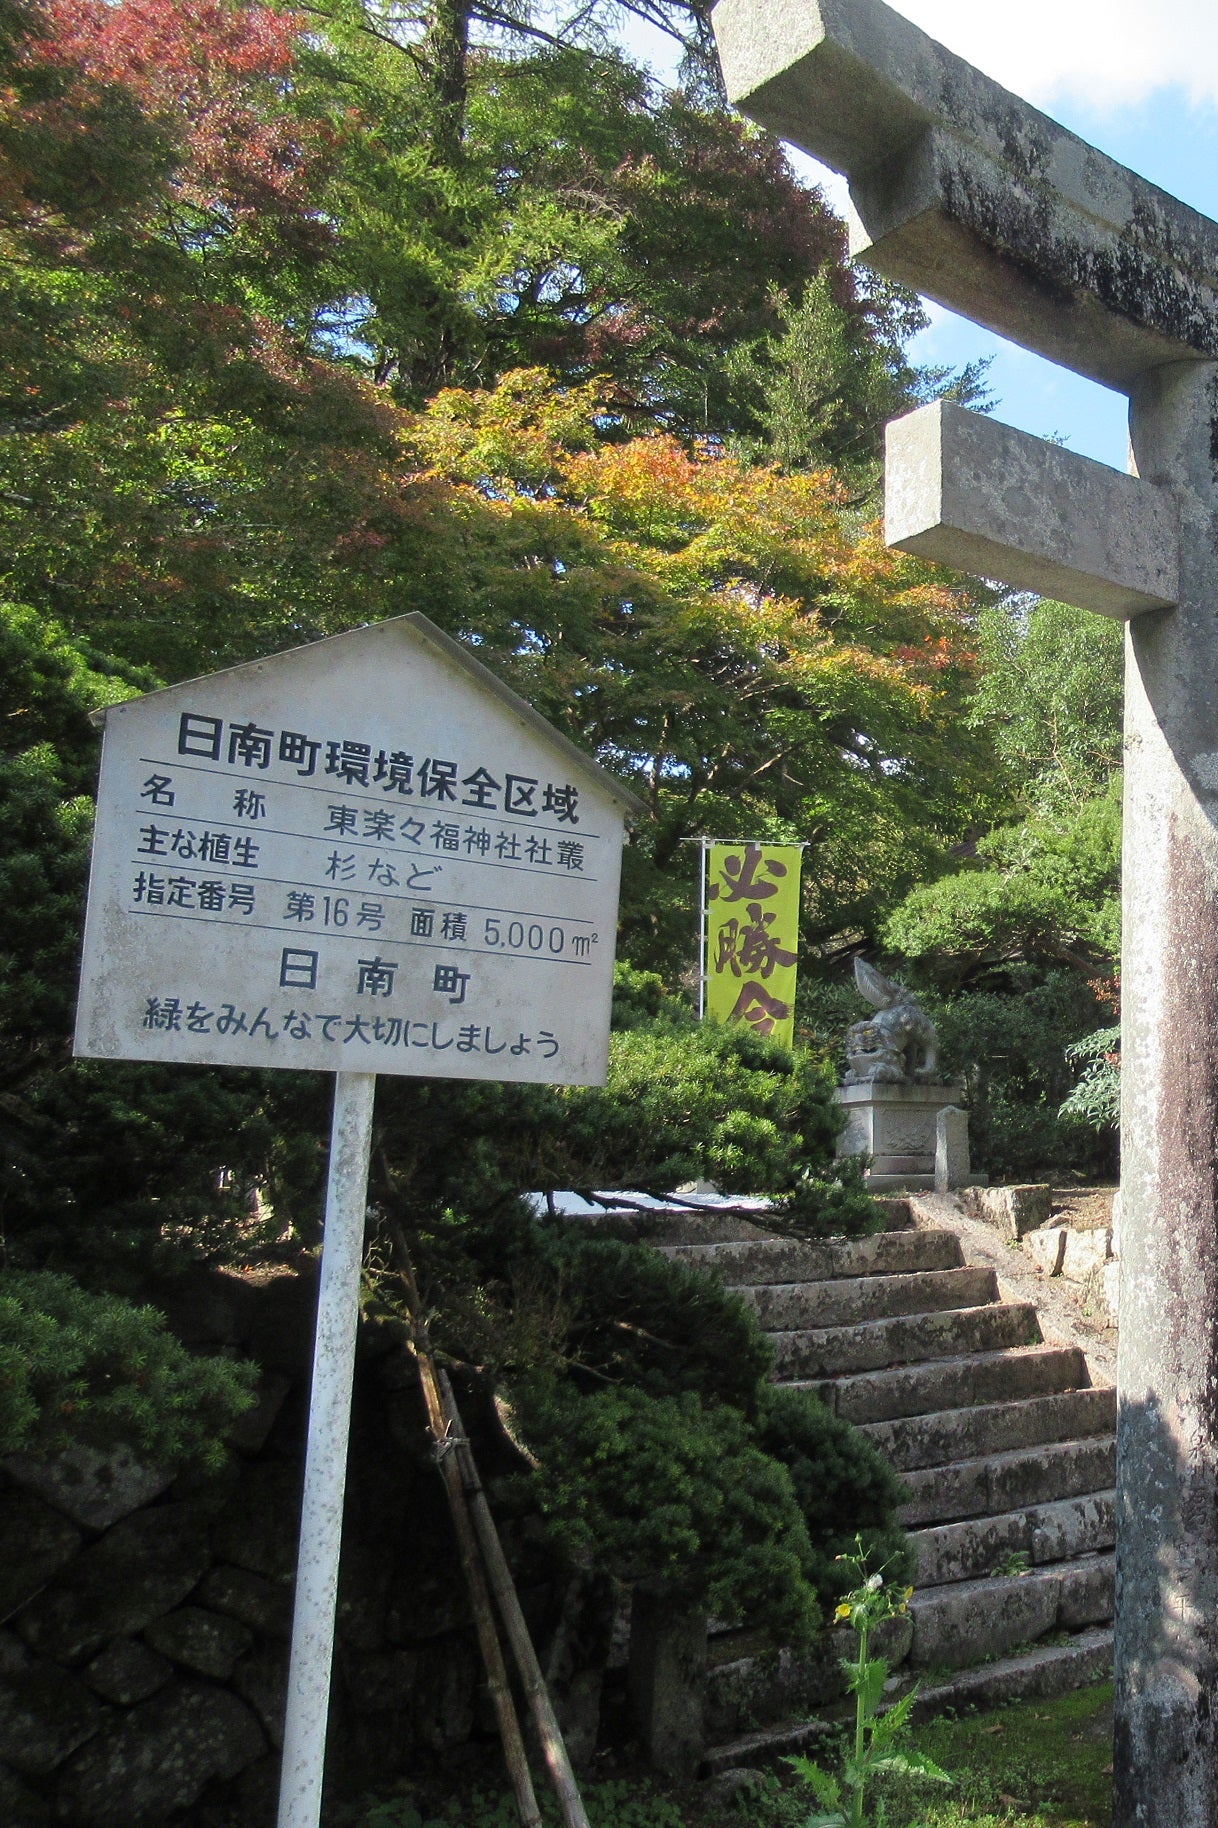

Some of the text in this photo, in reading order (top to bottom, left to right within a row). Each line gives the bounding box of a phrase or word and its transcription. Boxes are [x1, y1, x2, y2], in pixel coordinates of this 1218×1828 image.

[178, 712, 579, 824] 日南町環境保全区域
[137, 825, 443, 891] 主な植生 杉など
[323, 804, 584, 872] 東楽々福神社社叢
[133, 871, 256, 915] 指定番号
[283, 890, 386, 932] 第16号
[410, 907, 468, 942] 面積
[142, 997, 560, 1059] 緑をみんなで大切にしましょう
